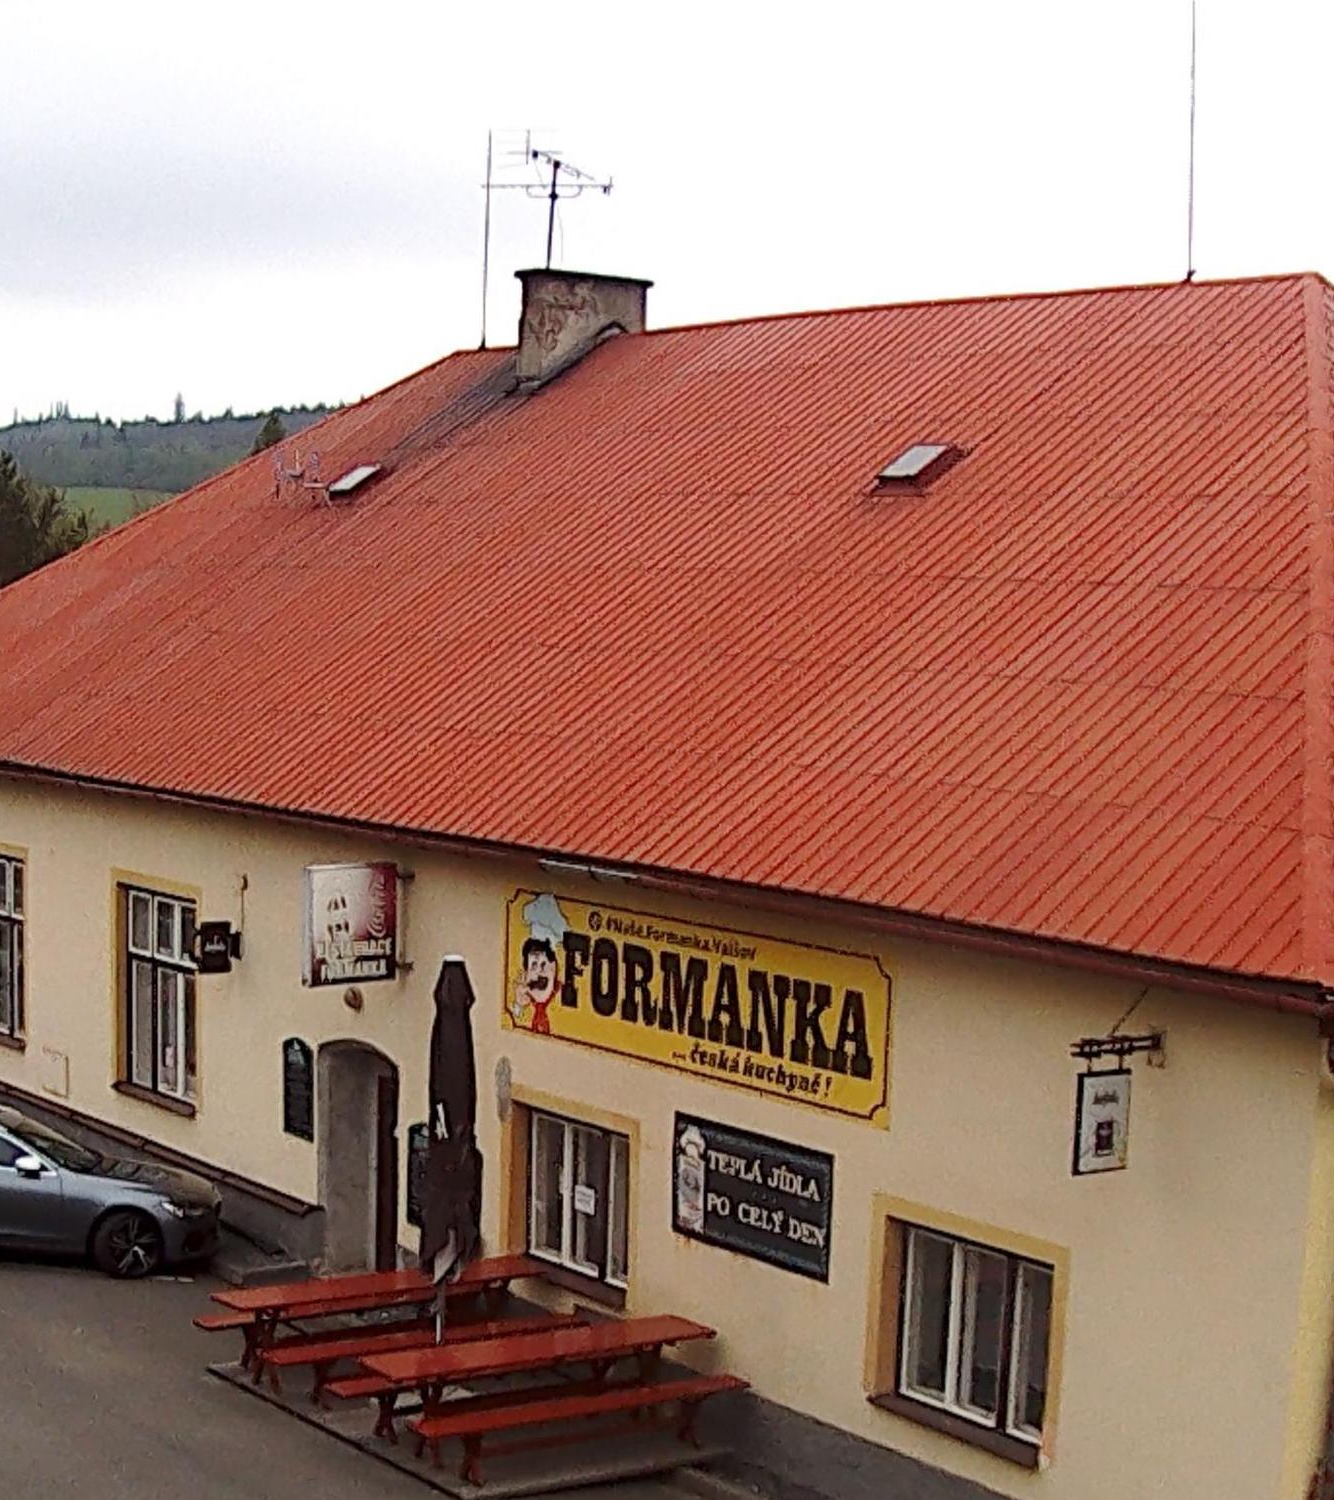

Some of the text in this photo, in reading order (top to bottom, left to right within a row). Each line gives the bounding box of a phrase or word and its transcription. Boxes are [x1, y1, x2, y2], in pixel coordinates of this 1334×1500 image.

[560, 931, 873, 1080] FORMANKA
[767, 1165, 821, 1202] JÍDLA
[707, 1192, 730, 1216] PO
[787, 1216, 827, 1249] DEN
